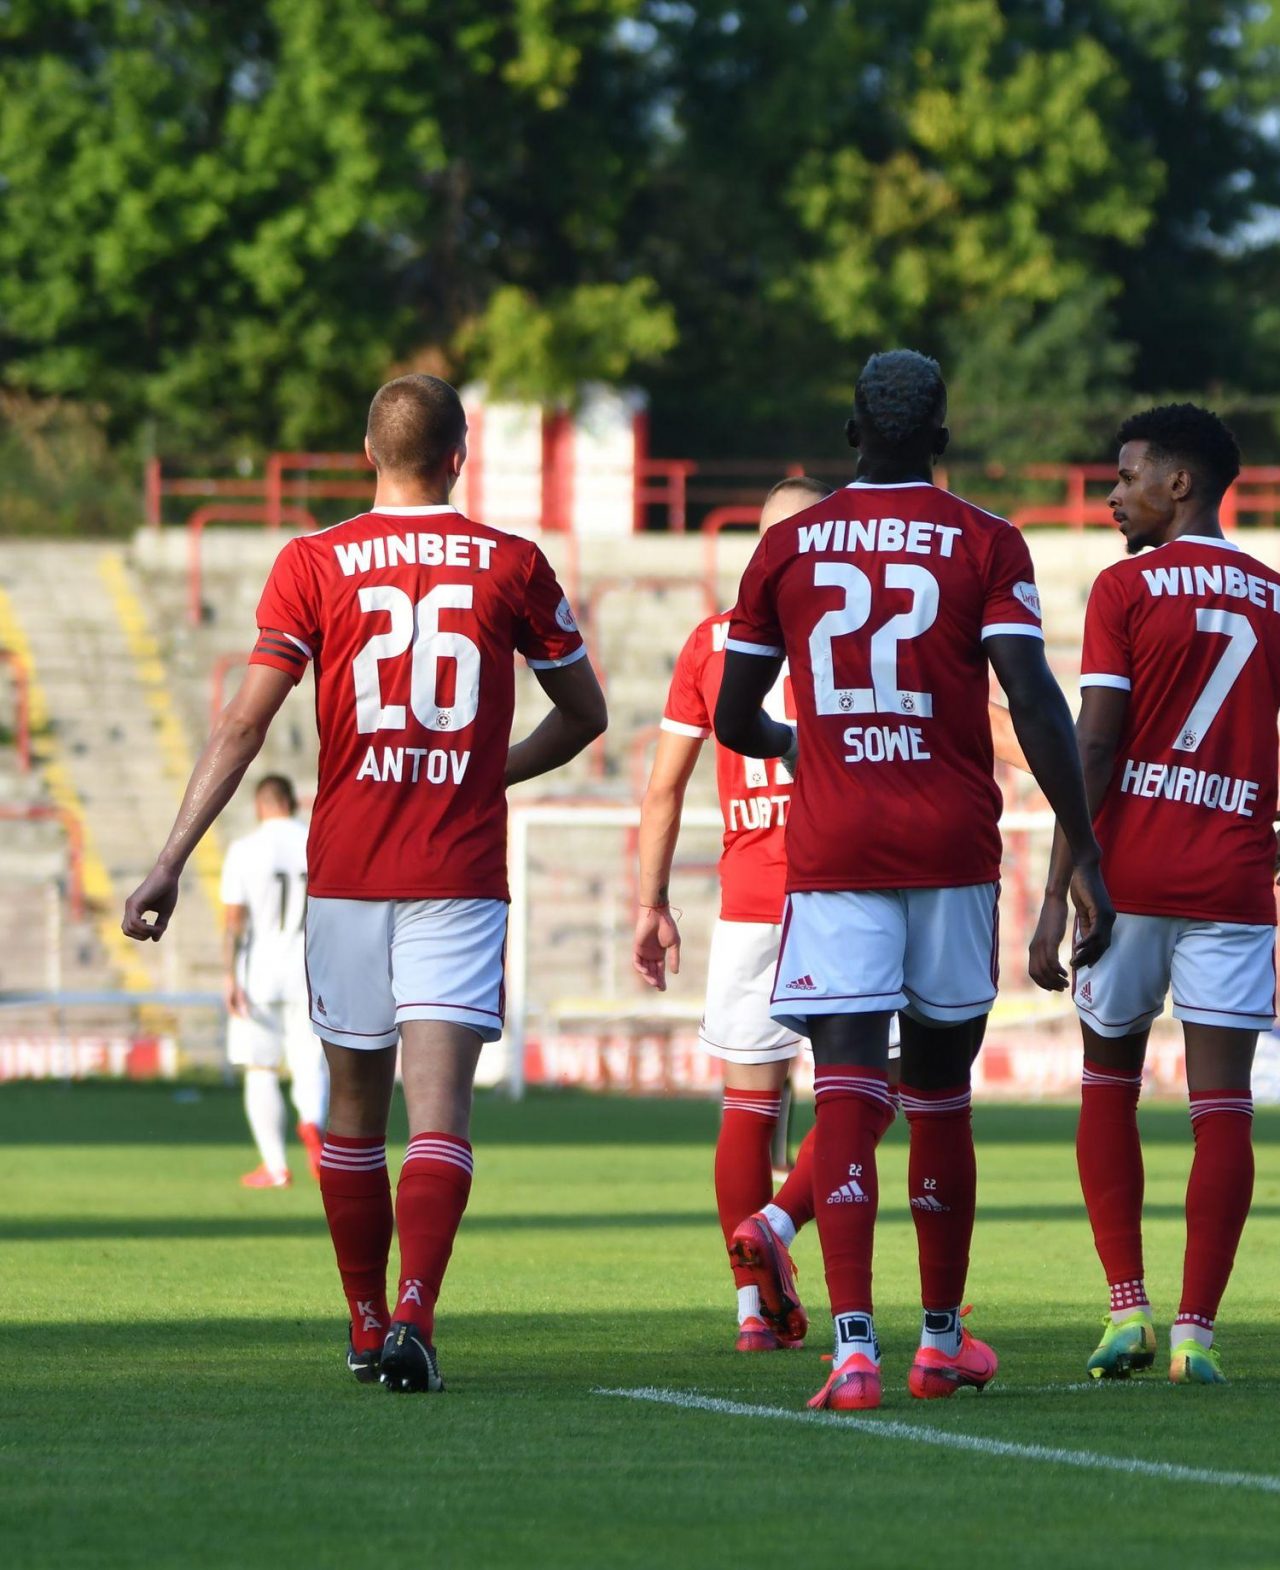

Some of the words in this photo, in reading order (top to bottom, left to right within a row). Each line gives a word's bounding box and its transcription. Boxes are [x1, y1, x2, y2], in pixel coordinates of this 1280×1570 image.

[334, 534, 498, 577] WINBET
[798, 517, 963, 559] WINBET
[352, 583, 481, 735] 26
[808, 561, 940, 718] 22
[1171, 608, 1259, 753] 7
[843, 724, 931, 763] SOWE
[355, 745, 471, 785] ANTOV
[1120, 758, 1259, 817] HENRIQUE
[848, 1163, 863, 1177] 22
[923, 1178, 937, 1190] 22
